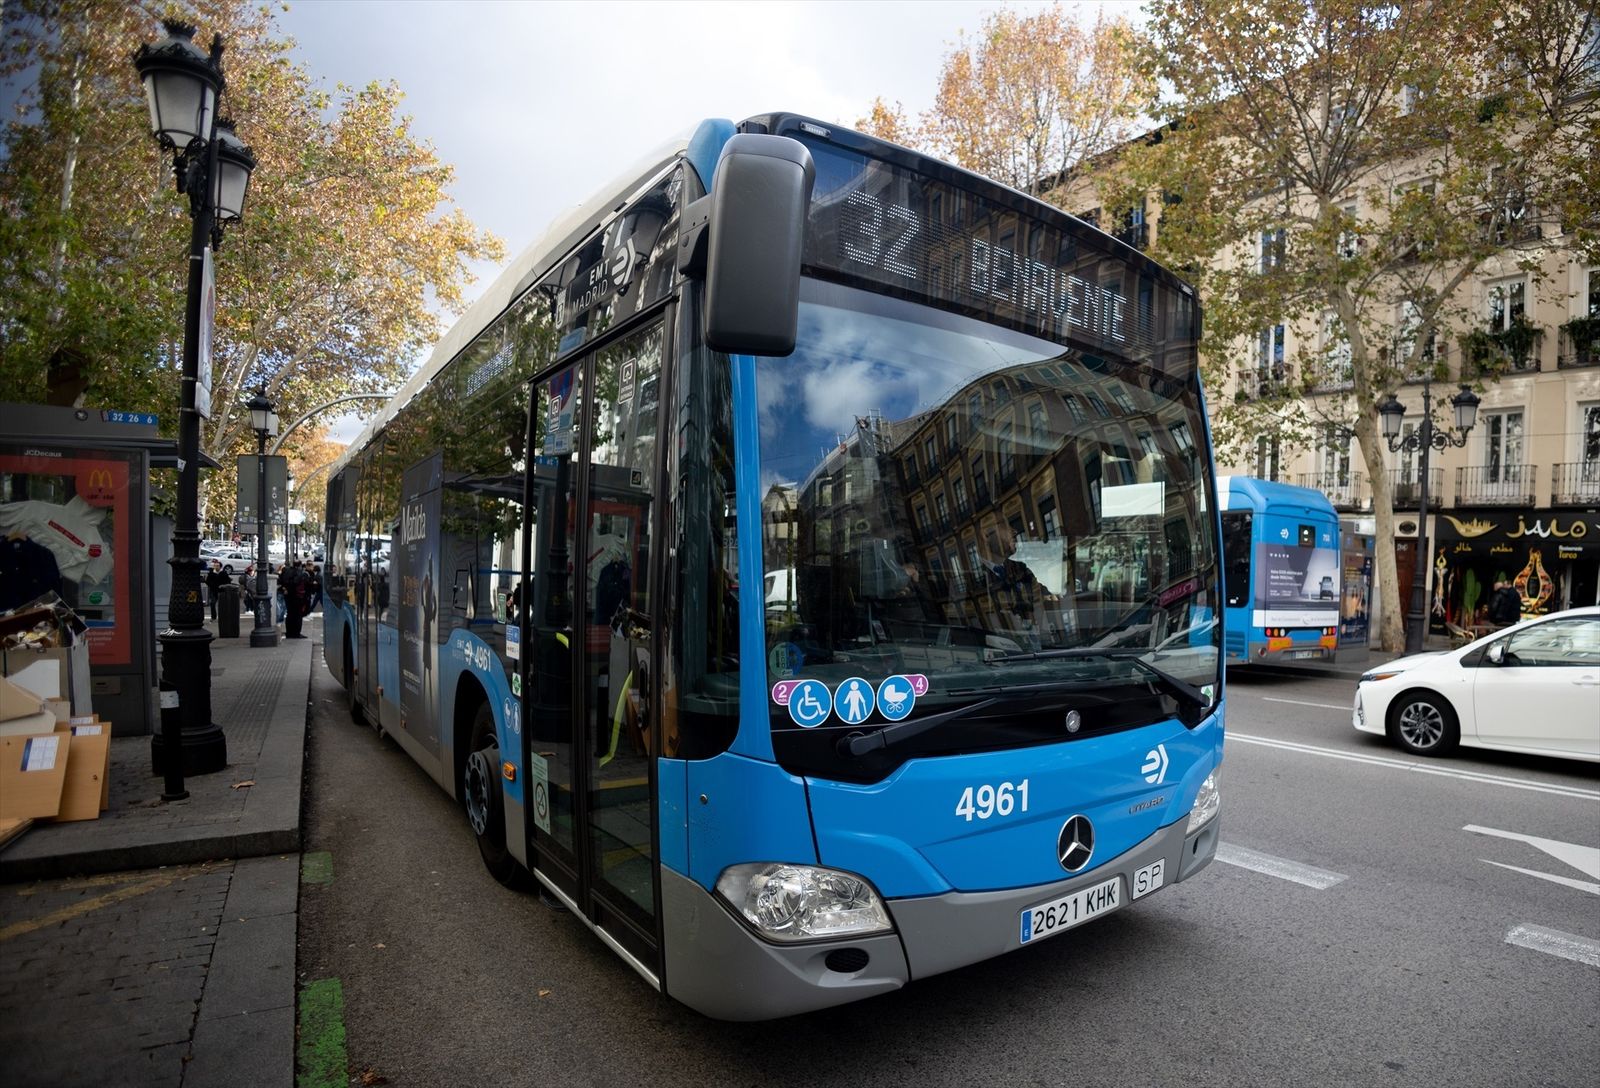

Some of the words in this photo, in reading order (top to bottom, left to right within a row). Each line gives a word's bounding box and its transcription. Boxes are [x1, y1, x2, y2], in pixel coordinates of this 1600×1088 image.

[589, 258, 610, 286] EMT
[845, 189, 920, 279] 32
[970, 238, 1127, 342] BENAVENTE
[572, 279, 608, 314] MADRID
[112, 413, 124, 421] 32
[128, 415, 139, 423] 26
[147, 416, 153, 424] 6
[24, 449, 62, 458] JCDecaux
[401, 503, 426, 546] Matilda
[474, 646, 491, 673] 4961
[778, 684, 788, 698] 2
[916, 677, 924, 690] 4
[955, 779, 1029, 822] 4961
[1137, 864, 1161, 893] SP
[1033, 897, 1078, 935] 2621
[1086, 882, 1116, 915] KHK
